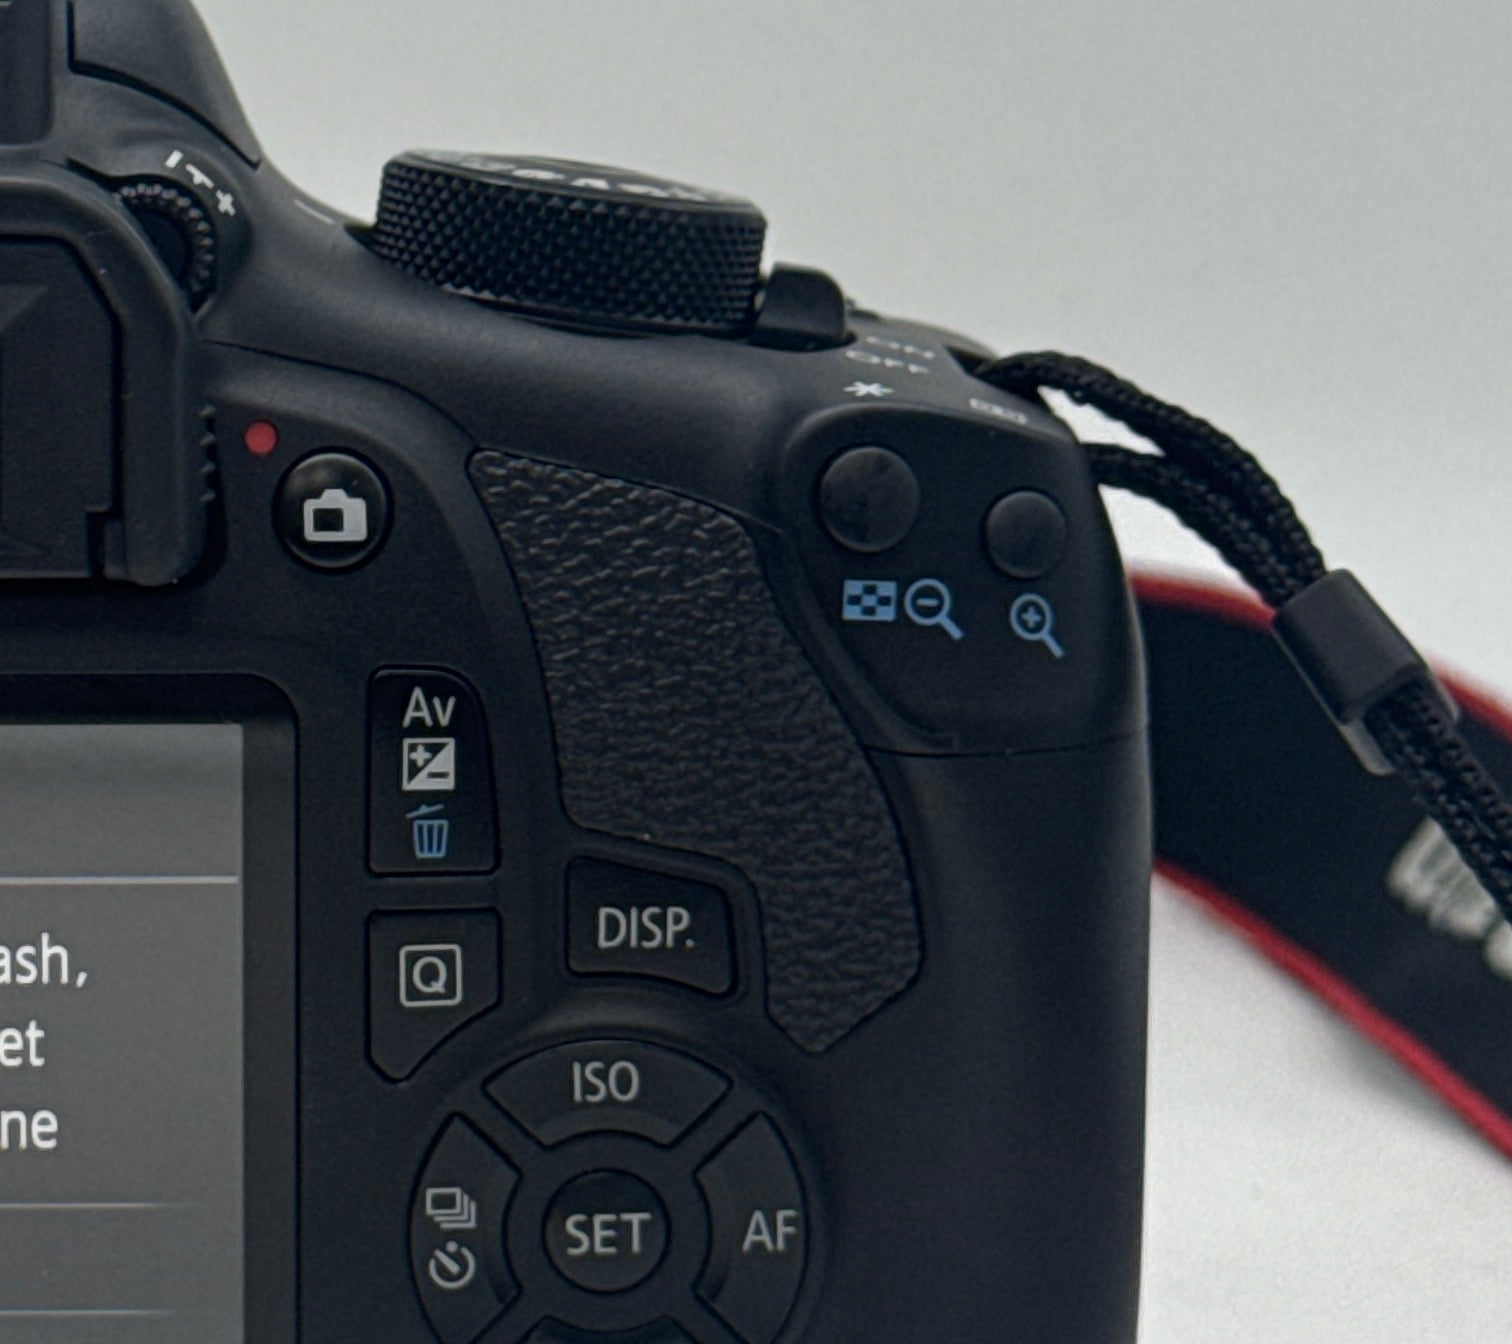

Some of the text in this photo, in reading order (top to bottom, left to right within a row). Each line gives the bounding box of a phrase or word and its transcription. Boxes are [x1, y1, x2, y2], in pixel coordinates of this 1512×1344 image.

[402, 686, 456, 728] Av
[597, 906, 695, 949] DISP.
[572, 1060, 640, 1103] ISO
[565, 1212, 652, 1256] SET
[742, 1209, 797, 1252] AF
